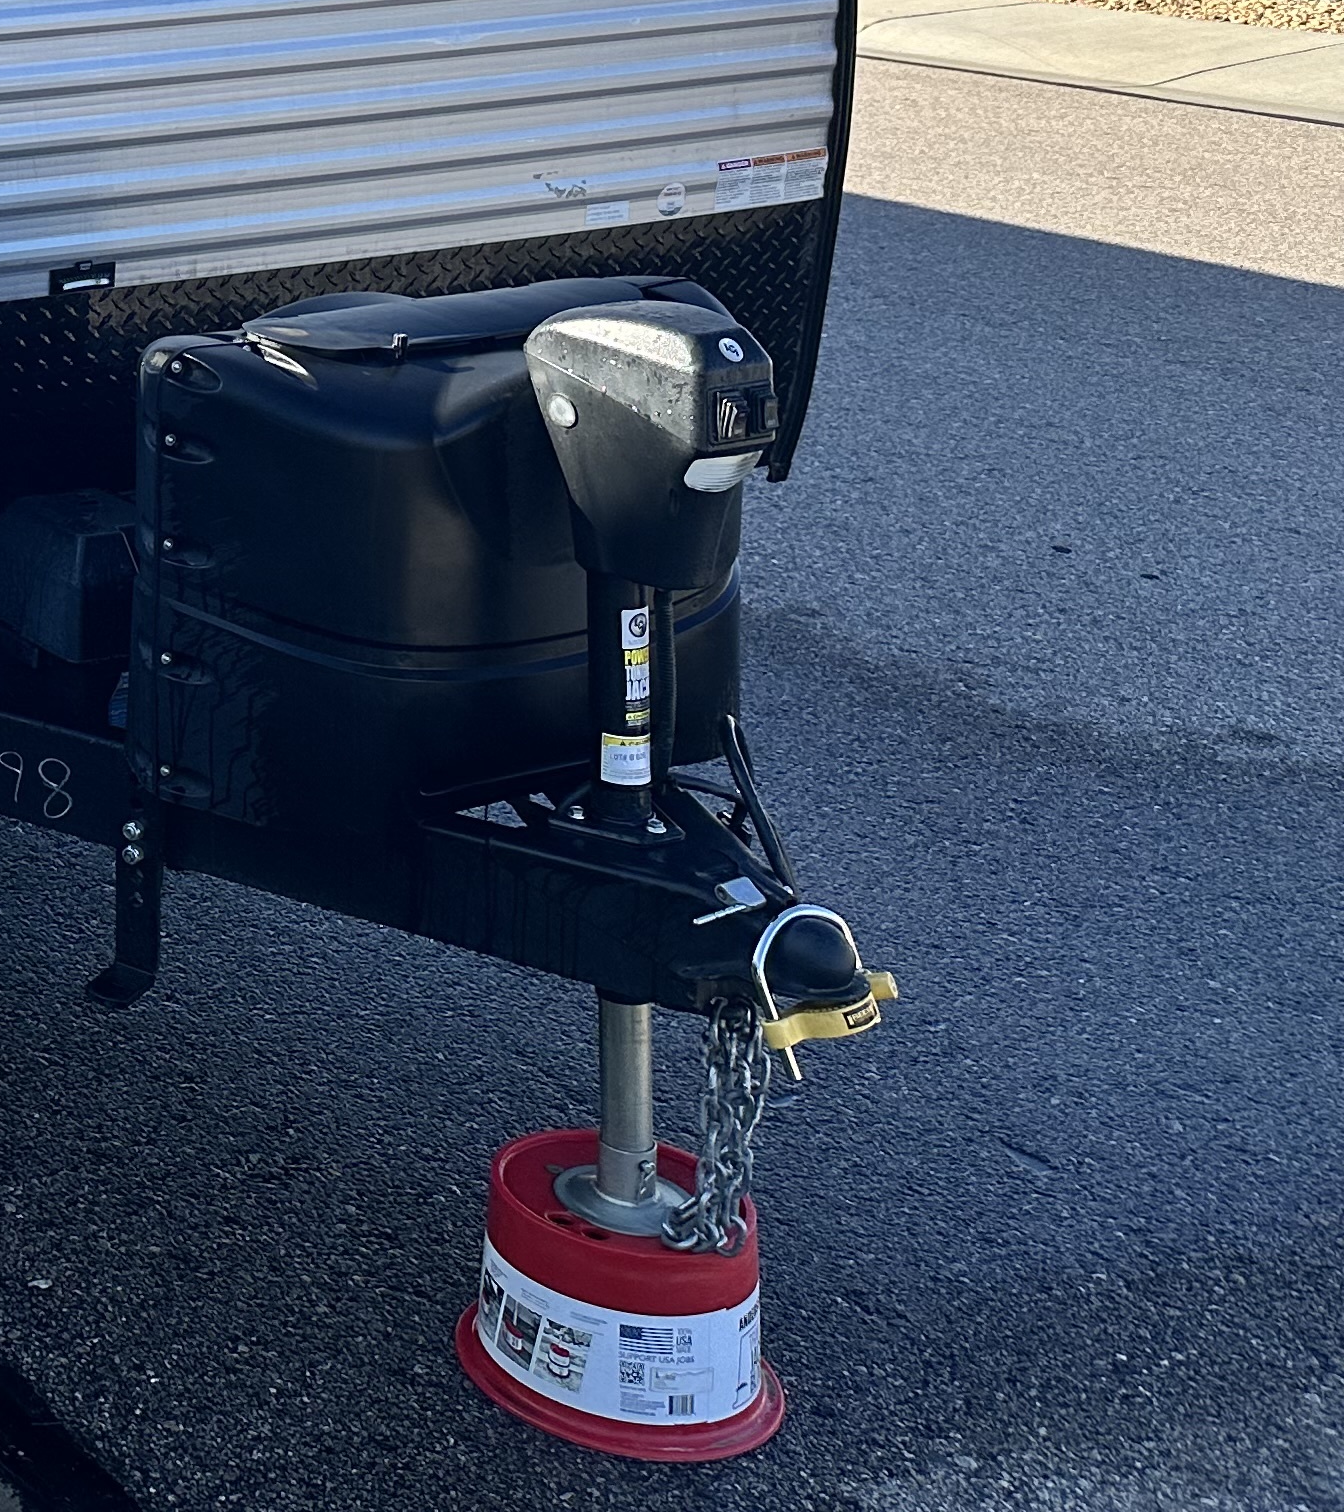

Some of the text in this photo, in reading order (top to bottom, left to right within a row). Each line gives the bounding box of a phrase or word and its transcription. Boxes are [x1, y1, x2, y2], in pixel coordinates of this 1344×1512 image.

[676, 1335, 693, 1346] USA
[618, 1351, 657, 1363] SUPPORT
[659, 1356, 675, 1364] USA
